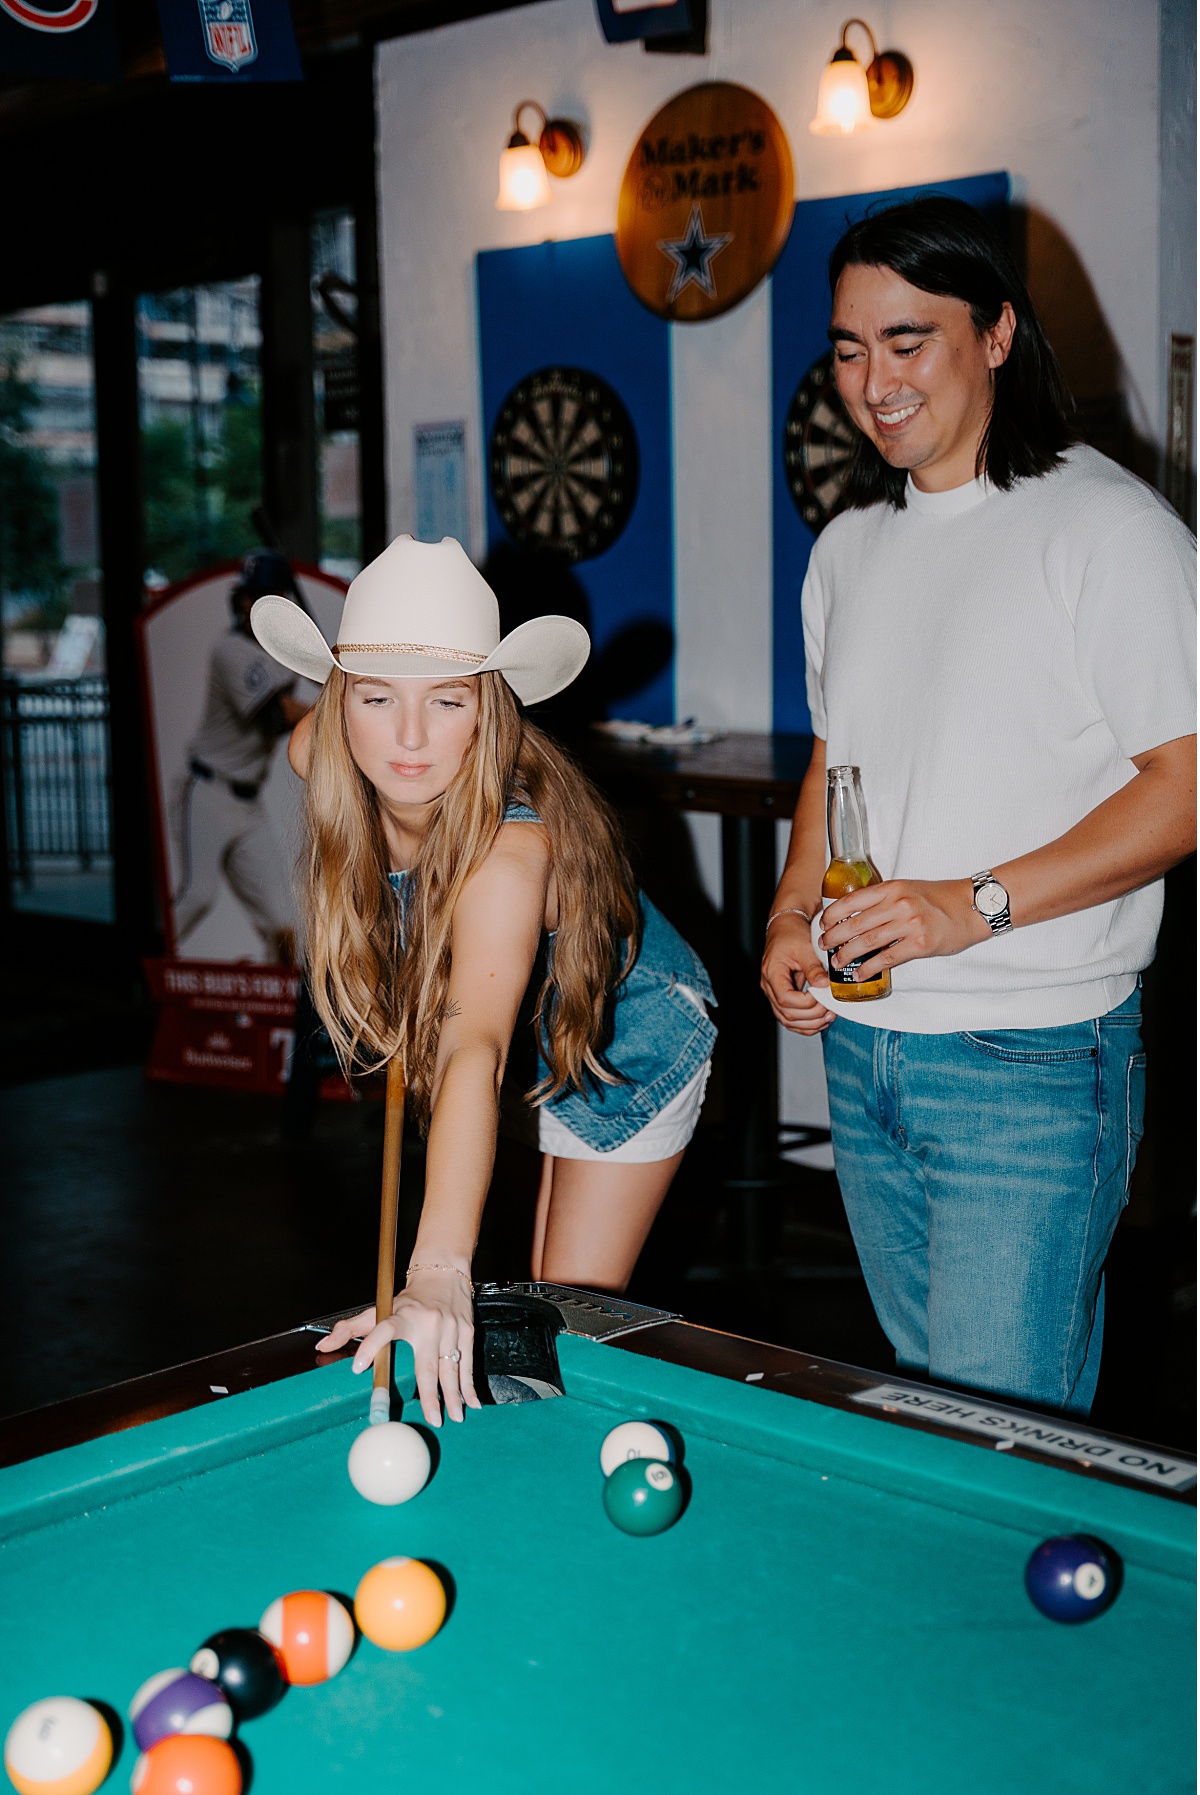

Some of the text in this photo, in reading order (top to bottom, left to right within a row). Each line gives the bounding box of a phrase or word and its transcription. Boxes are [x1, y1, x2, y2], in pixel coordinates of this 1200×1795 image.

[209, 24, 249, 58] NFL
[641, 128, 767, 167] Maker's
[671, 163, 759, 201] Mark
[164, 968, 199, 993] THIS
[182, 1046, 254, 1071] Budweiser
[269, 1027, 297, 1083] 7
[881, 1391, 1177, 1477] NO DRINKS HERE
